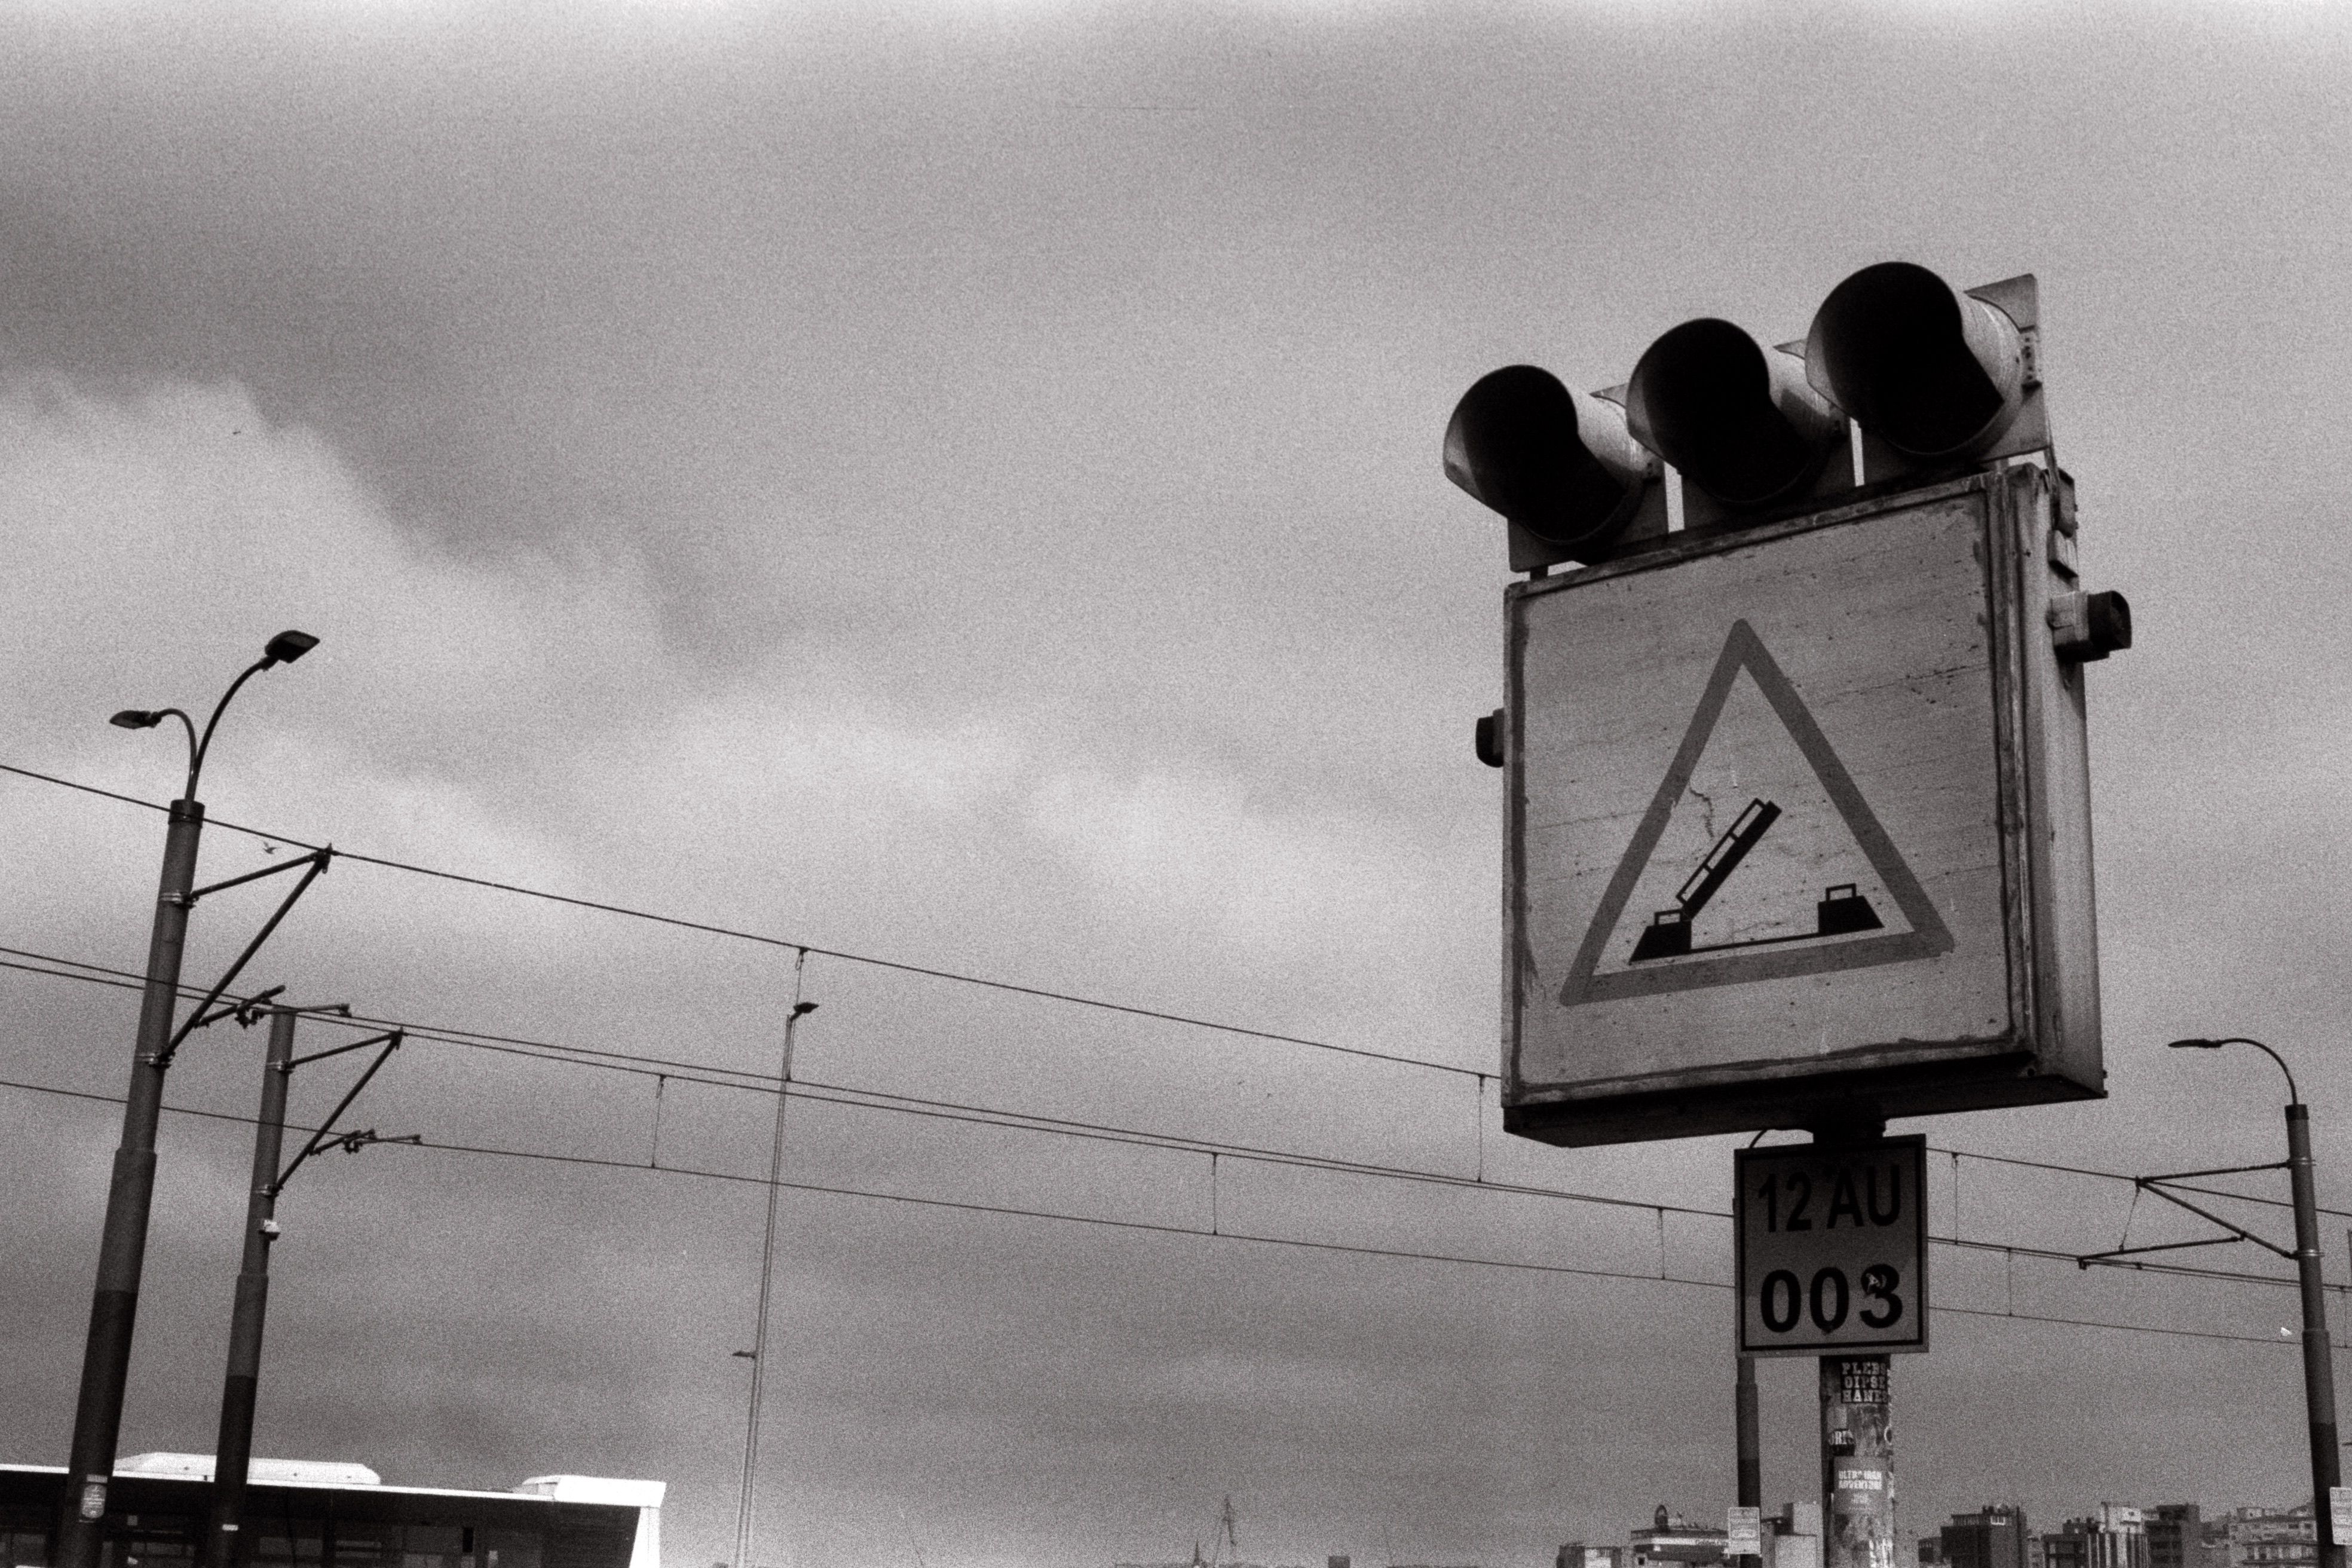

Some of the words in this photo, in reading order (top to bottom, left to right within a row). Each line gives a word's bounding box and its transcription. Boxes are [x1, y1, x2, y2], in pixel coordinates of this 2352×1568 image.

[1758, 1171, 1812, 1233] 12
[1827, 1164, 1901, 1230] AU
[1760, 1263, 1903, 1333] 003
